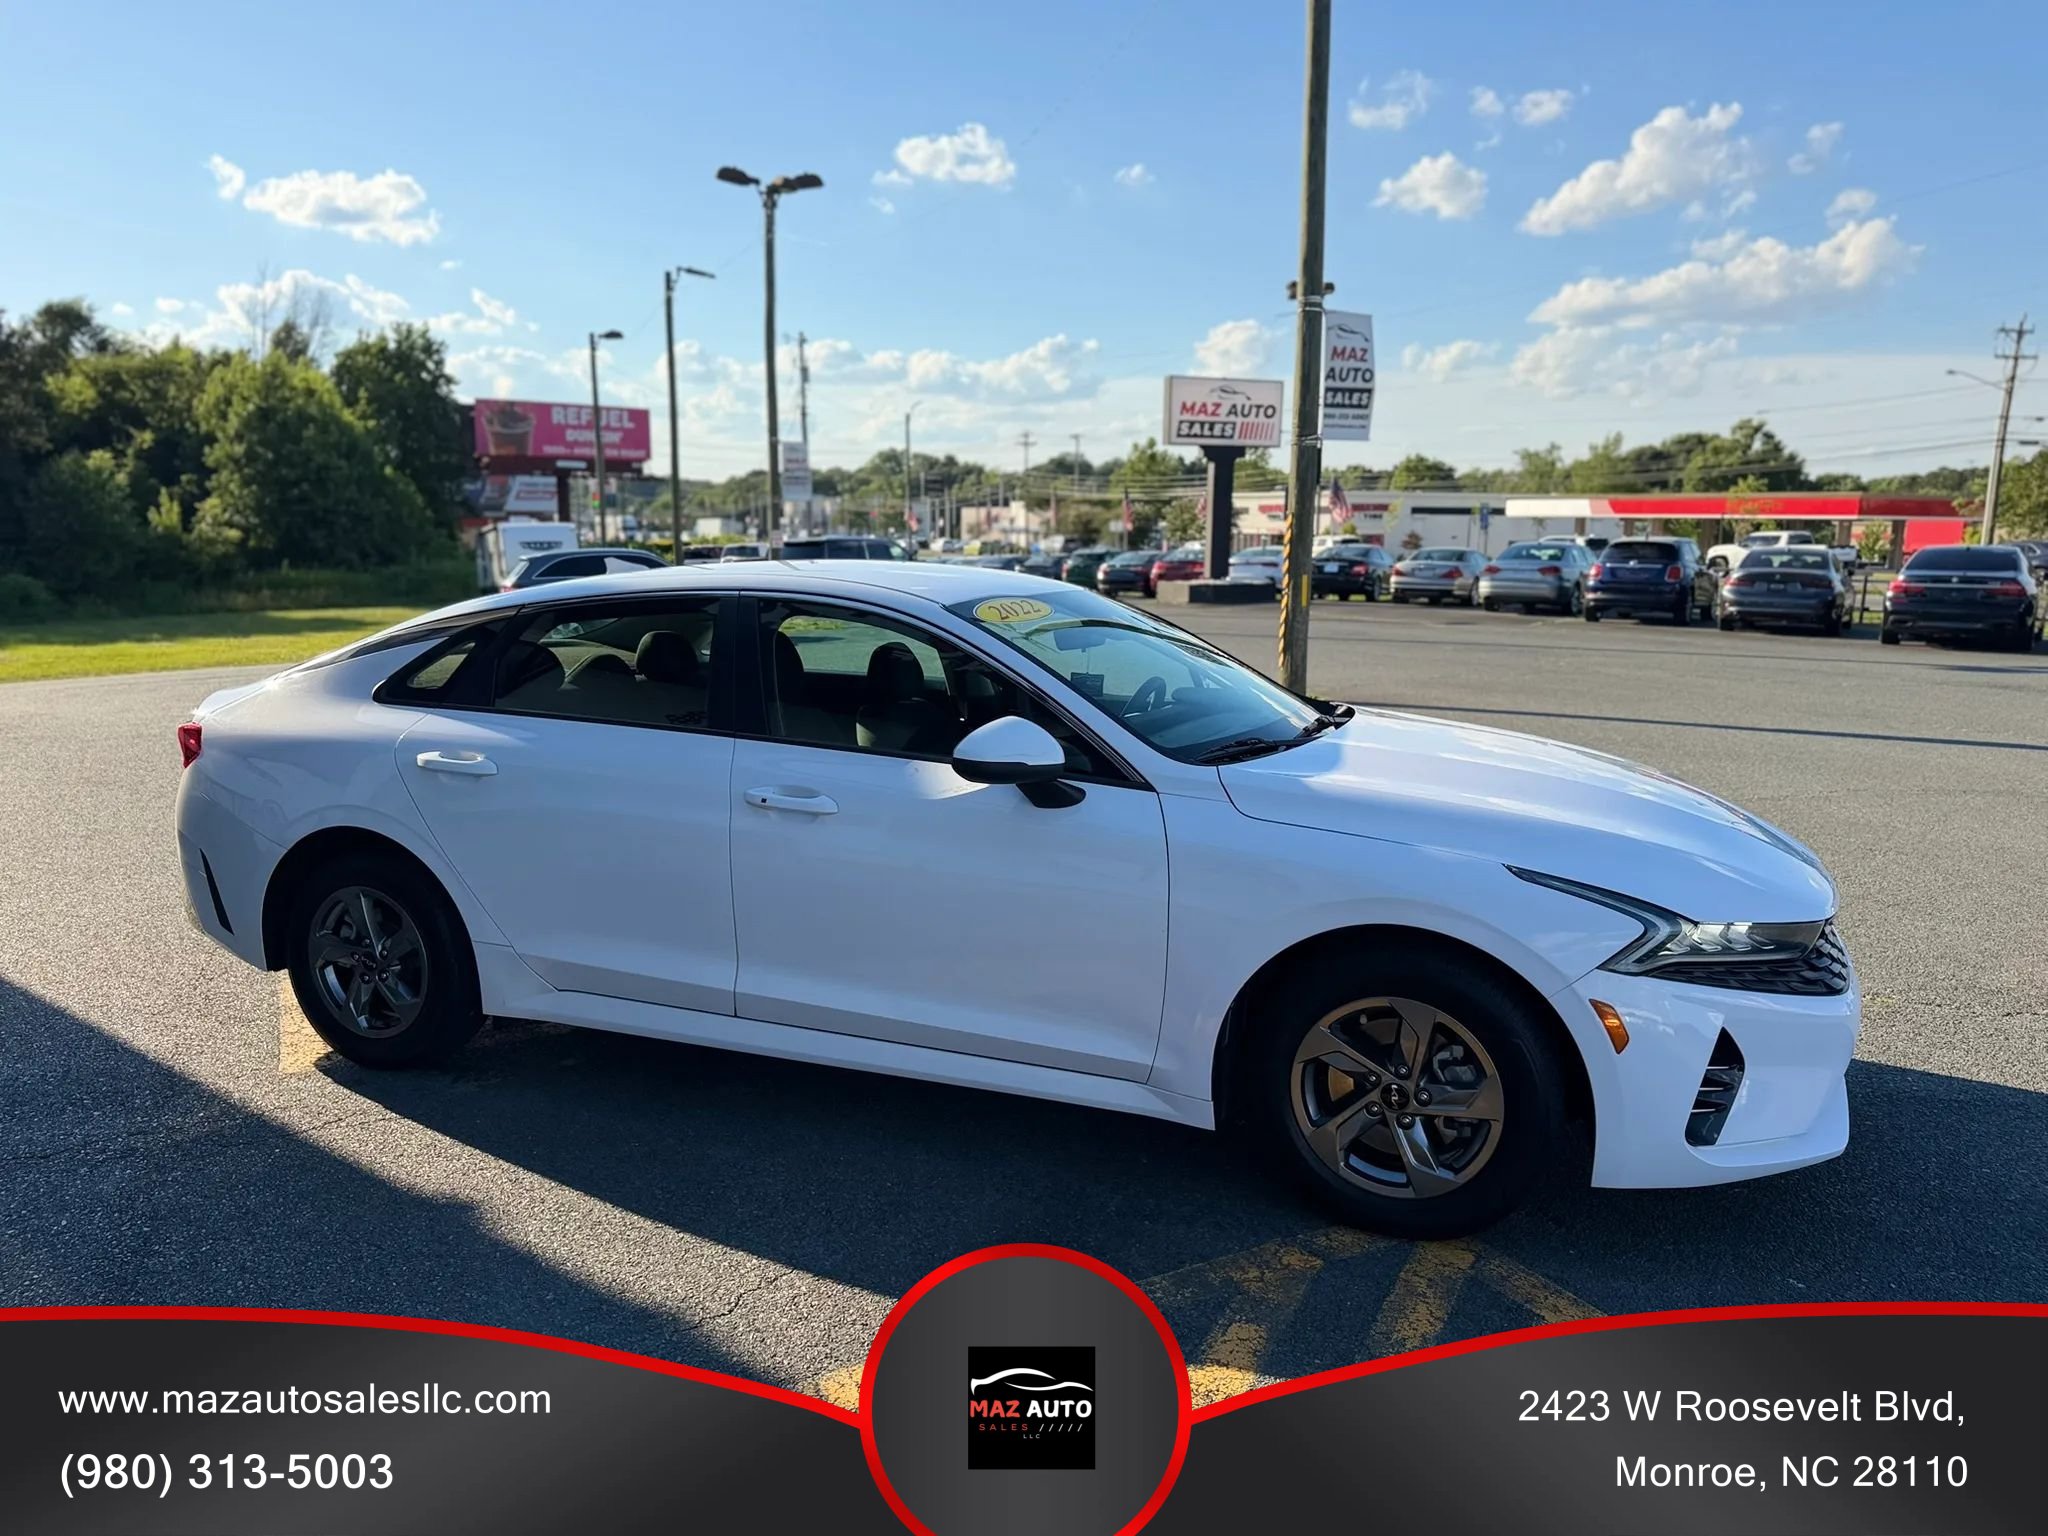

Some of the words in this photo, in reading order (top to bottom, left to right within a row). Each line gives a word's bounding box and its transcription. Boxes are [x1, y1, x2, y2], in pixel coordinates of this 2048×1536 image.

[1331, 346, 1368, 362] MAZ
[1325, 367, 1374, 383] AUTO
[1325, 390, 1370, 405] SALES
[1180, 401, 1221, 416] MAZ
[1225, 404, 1277, 419] AUTO
[1177, 422, 1234, 438] SALES
[987, 599, 1042, 621] 2022
